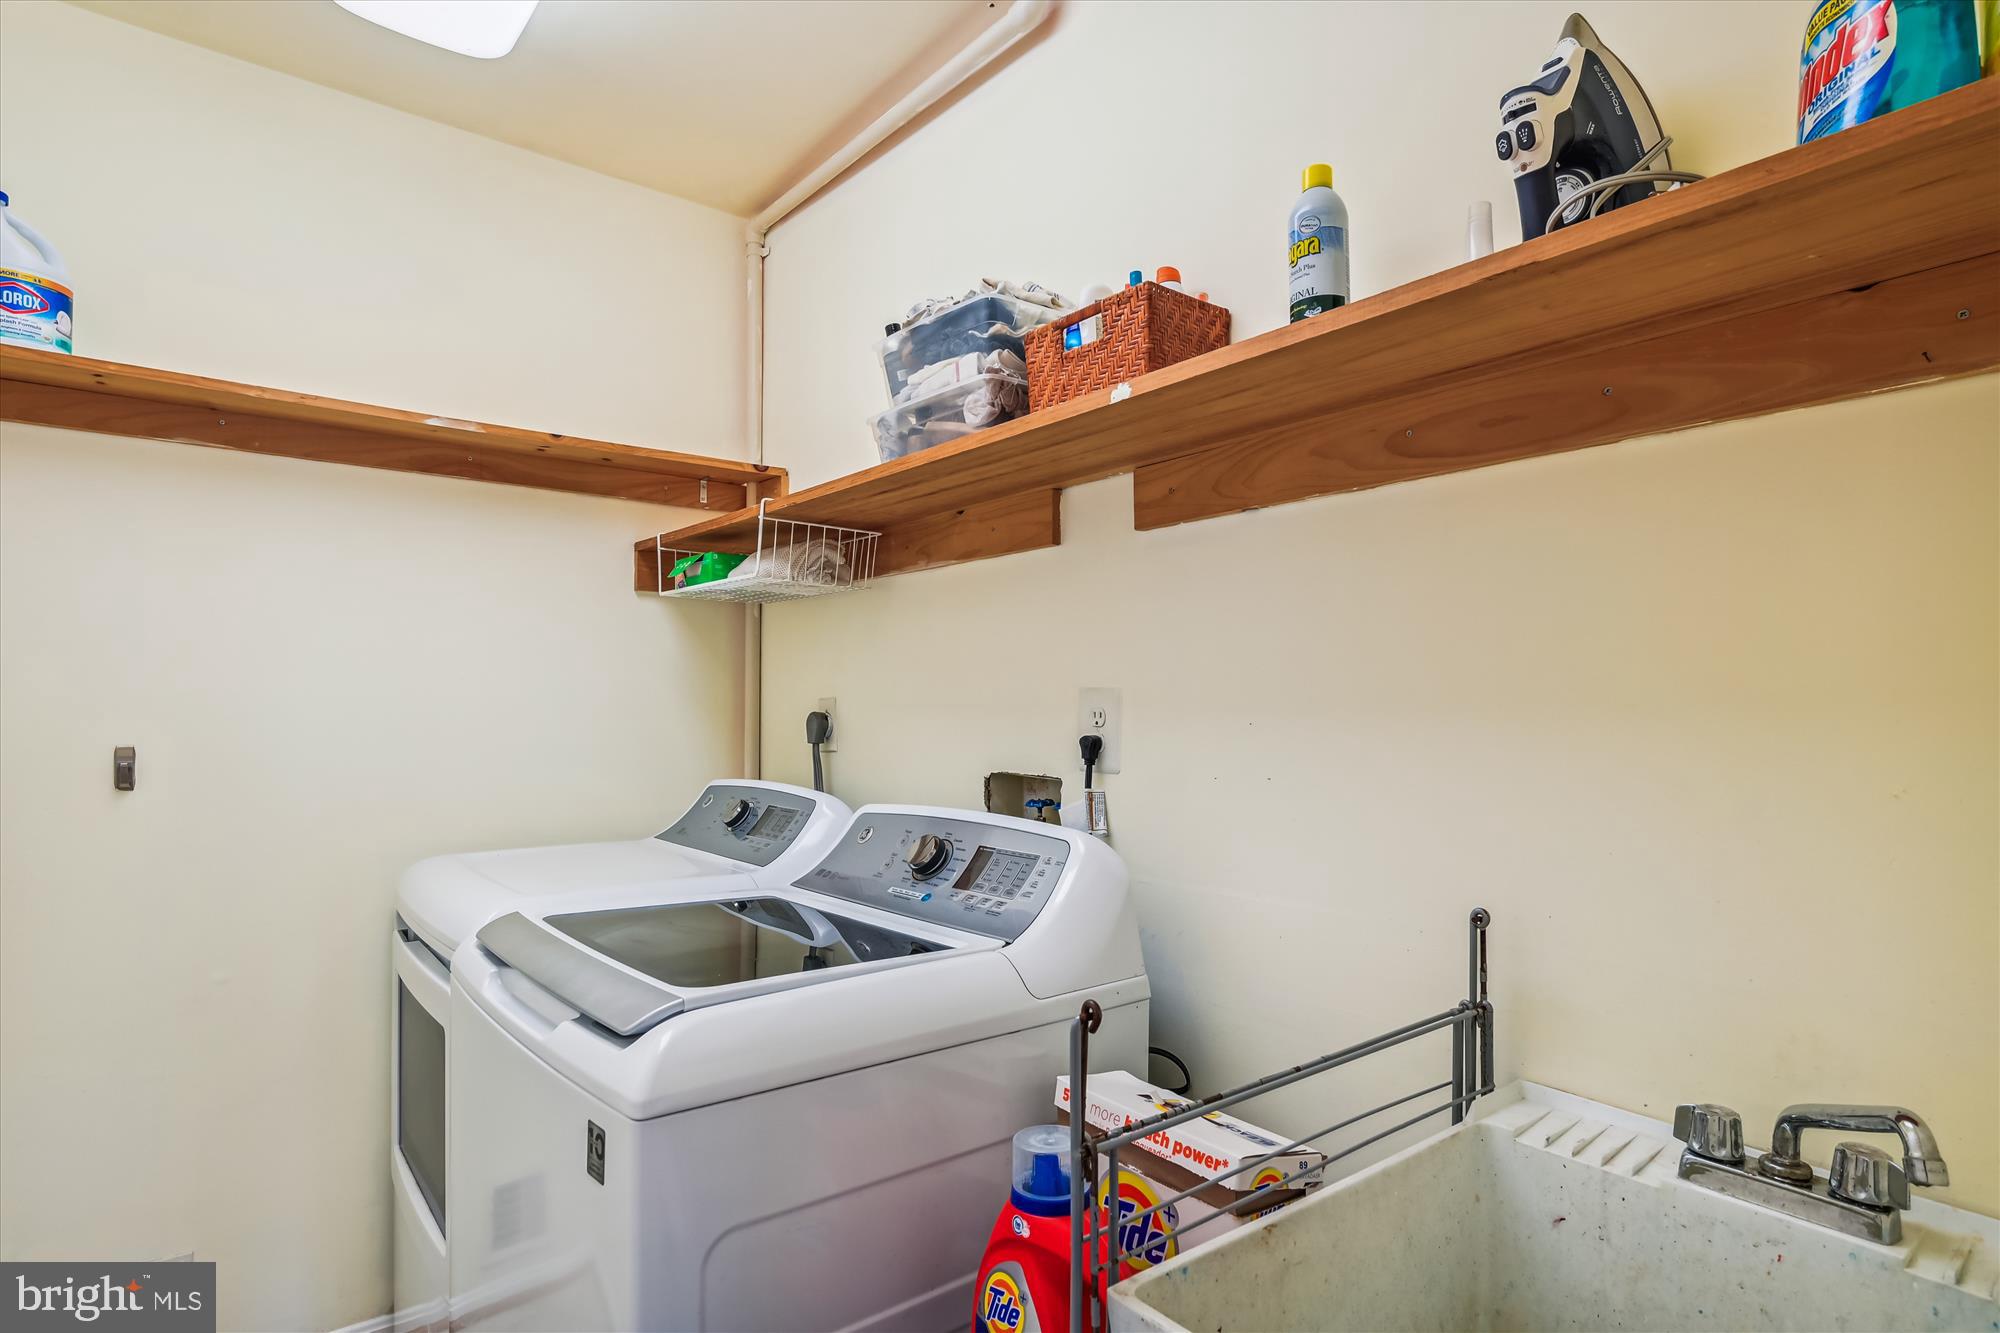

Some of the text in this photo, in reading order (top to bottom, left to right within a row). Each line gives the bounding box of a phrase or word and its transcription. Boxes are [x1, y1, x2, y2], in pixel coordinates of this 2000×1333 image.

[0, 289, 42, 312] OROX
[1089, 1103, 1121, 1126] more
[985, 1285, 1021, 1328] Tide
